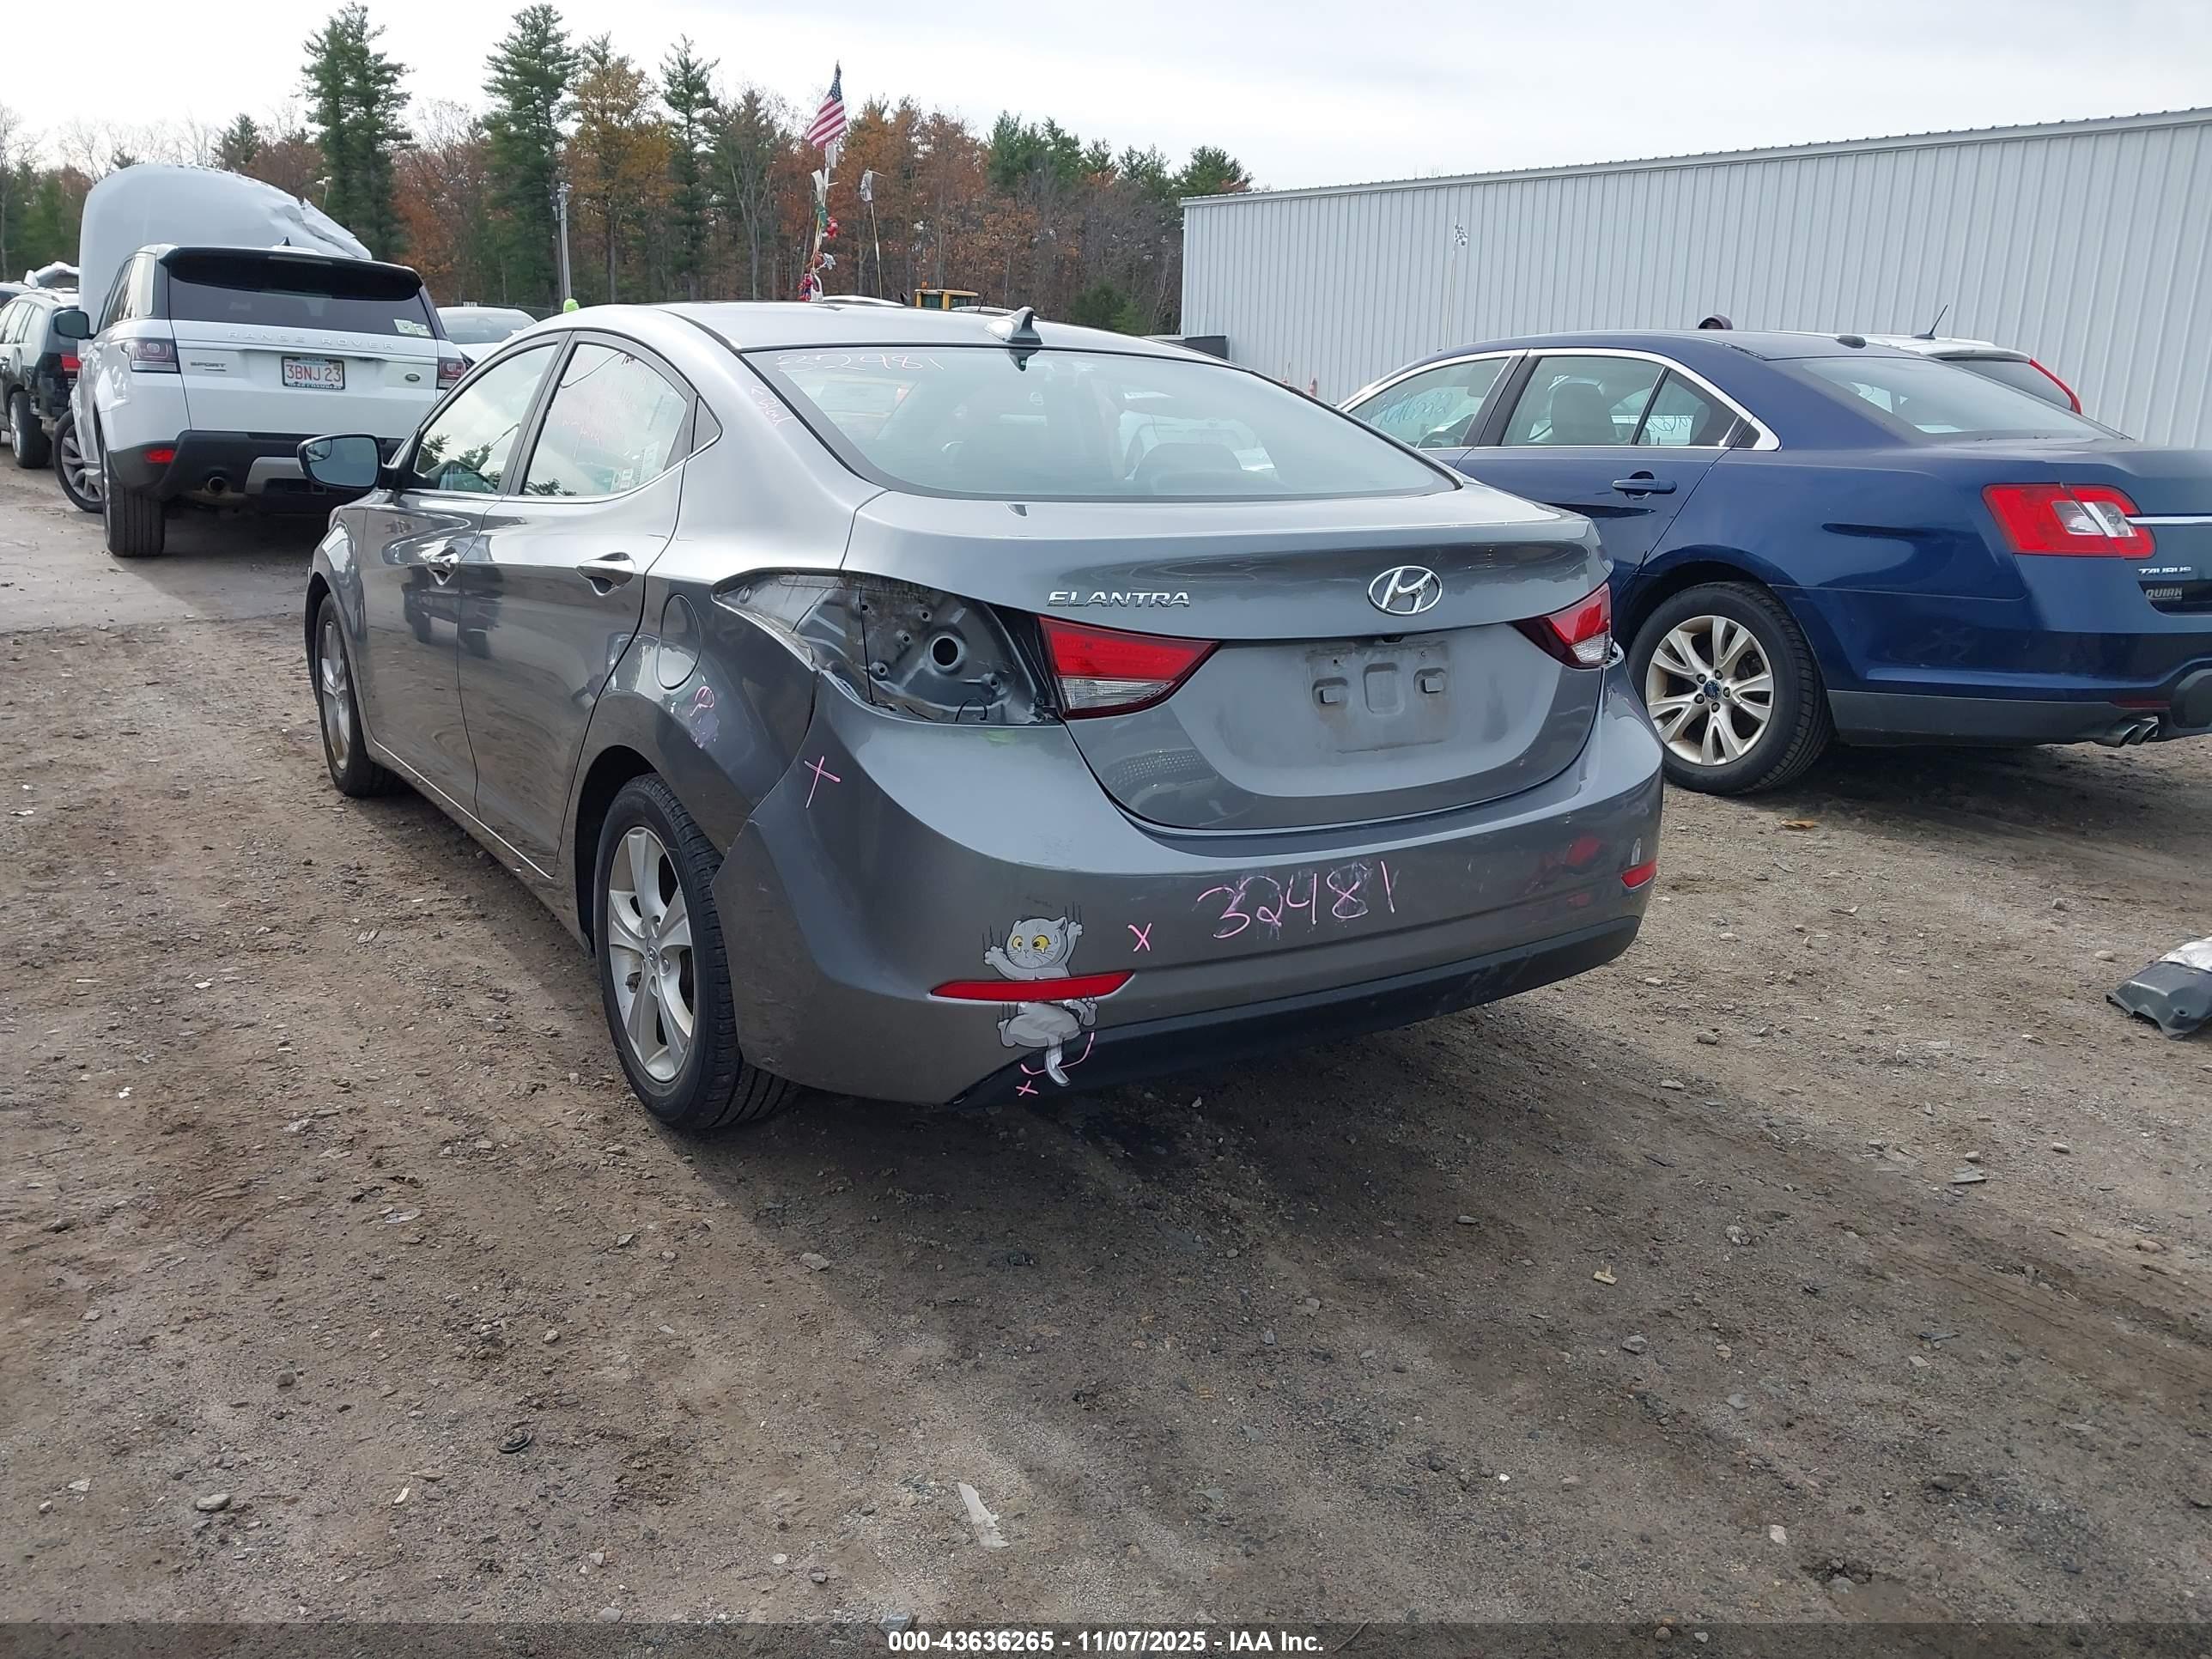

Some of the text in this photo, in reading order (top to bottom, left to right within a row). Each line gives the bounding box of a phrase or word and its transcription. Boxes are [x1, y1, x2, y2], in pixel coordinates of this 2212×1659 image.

[228, 331, 395, 349] RANGE ROVER
[776, 353, 945, 373] 32481
[285, 363, 342, 382] 3BNJ 23
[2137, 566, 2192, 574] TAURUS
[1047, 591, 1190, 608] ELANTRA
[1195, 860, 1395, 939] 32481
